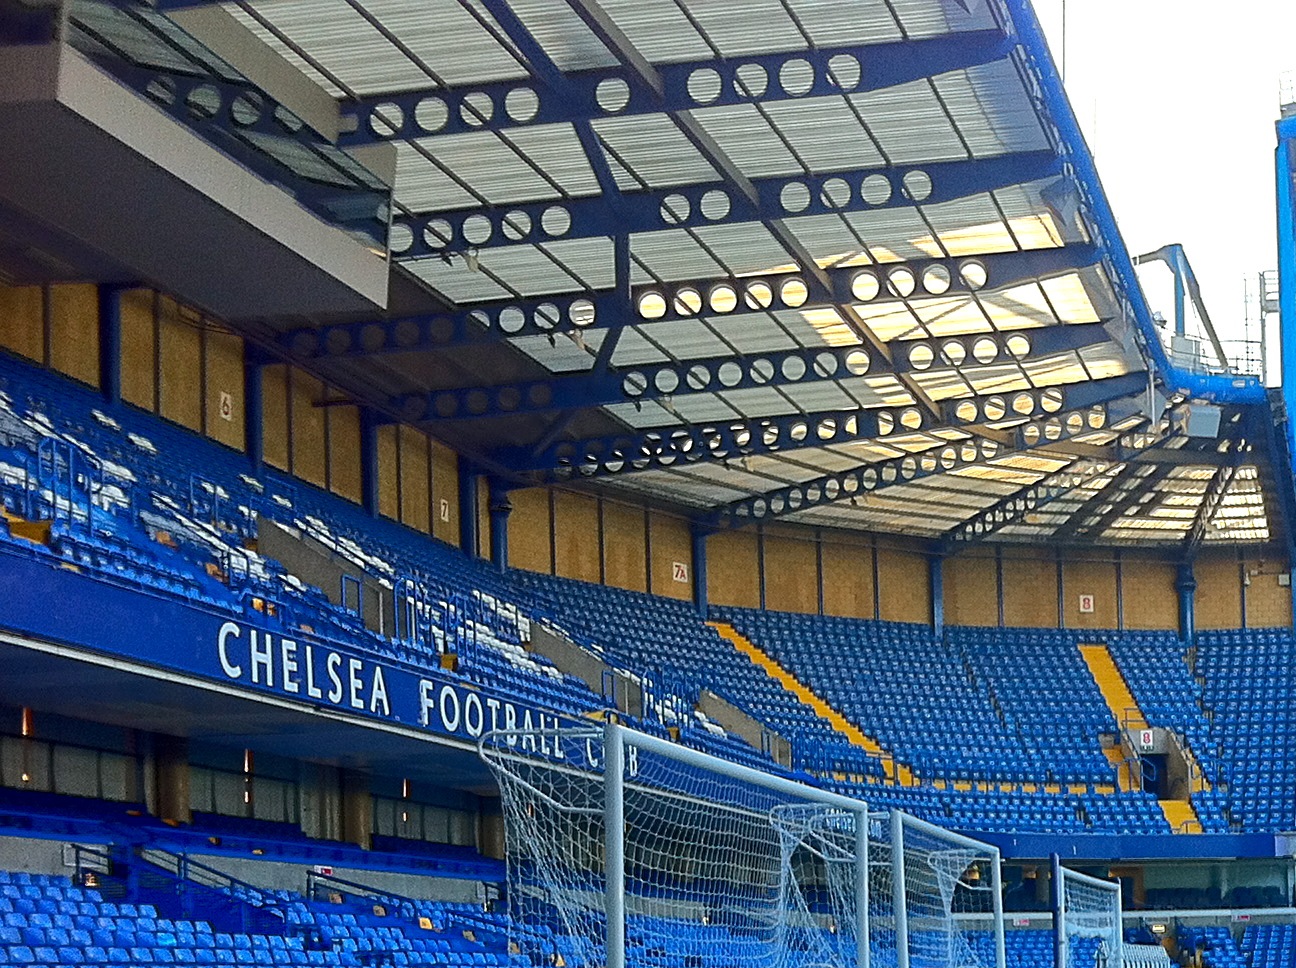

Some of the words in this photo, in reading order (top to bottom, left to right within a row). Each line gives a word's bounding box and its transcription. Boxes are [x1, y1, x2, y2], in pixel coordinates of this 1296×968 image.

[217, 621, 390, 717] CHELSEA
[419, 678, 564, 759] FOOTBALL
[586, 735, 638, 778] CB
